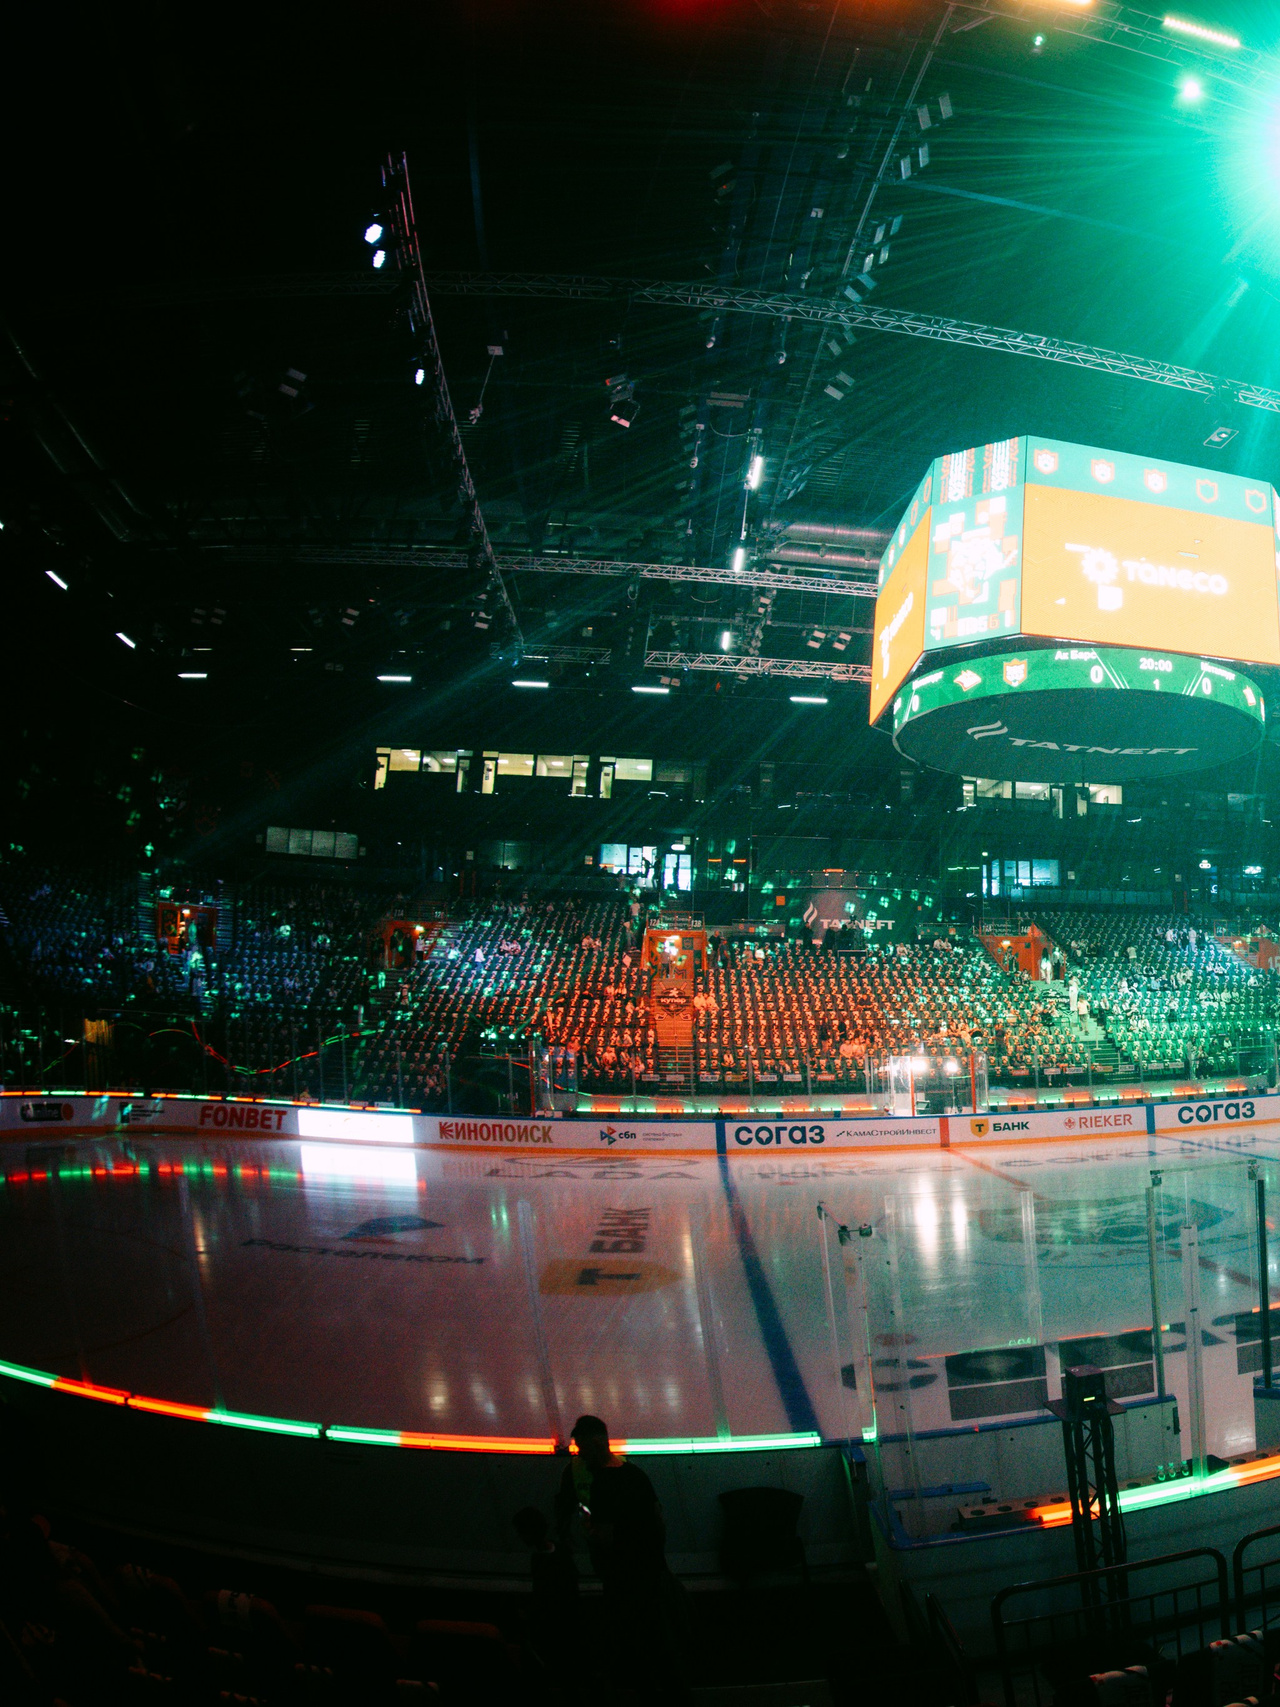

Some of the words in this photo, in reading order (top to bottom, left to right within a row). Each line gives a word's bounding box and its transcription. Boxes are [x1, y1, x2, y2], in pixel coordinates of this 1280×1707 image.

[1139, 657, 1173, 672] 20:00
[1090, 665, 1103, 684] 0
[1202, 677, 1212, 695] 0
[1007, 737, 1199, 756] TATNEFT
[200, 1105, 288, 1131] FONBET
[992, 1121, 1030, 1132] БАНК
[1079, 1113, 1133, 1129] RIEKER
[439, 1121, 553, 1144] КИНОПОИСК
